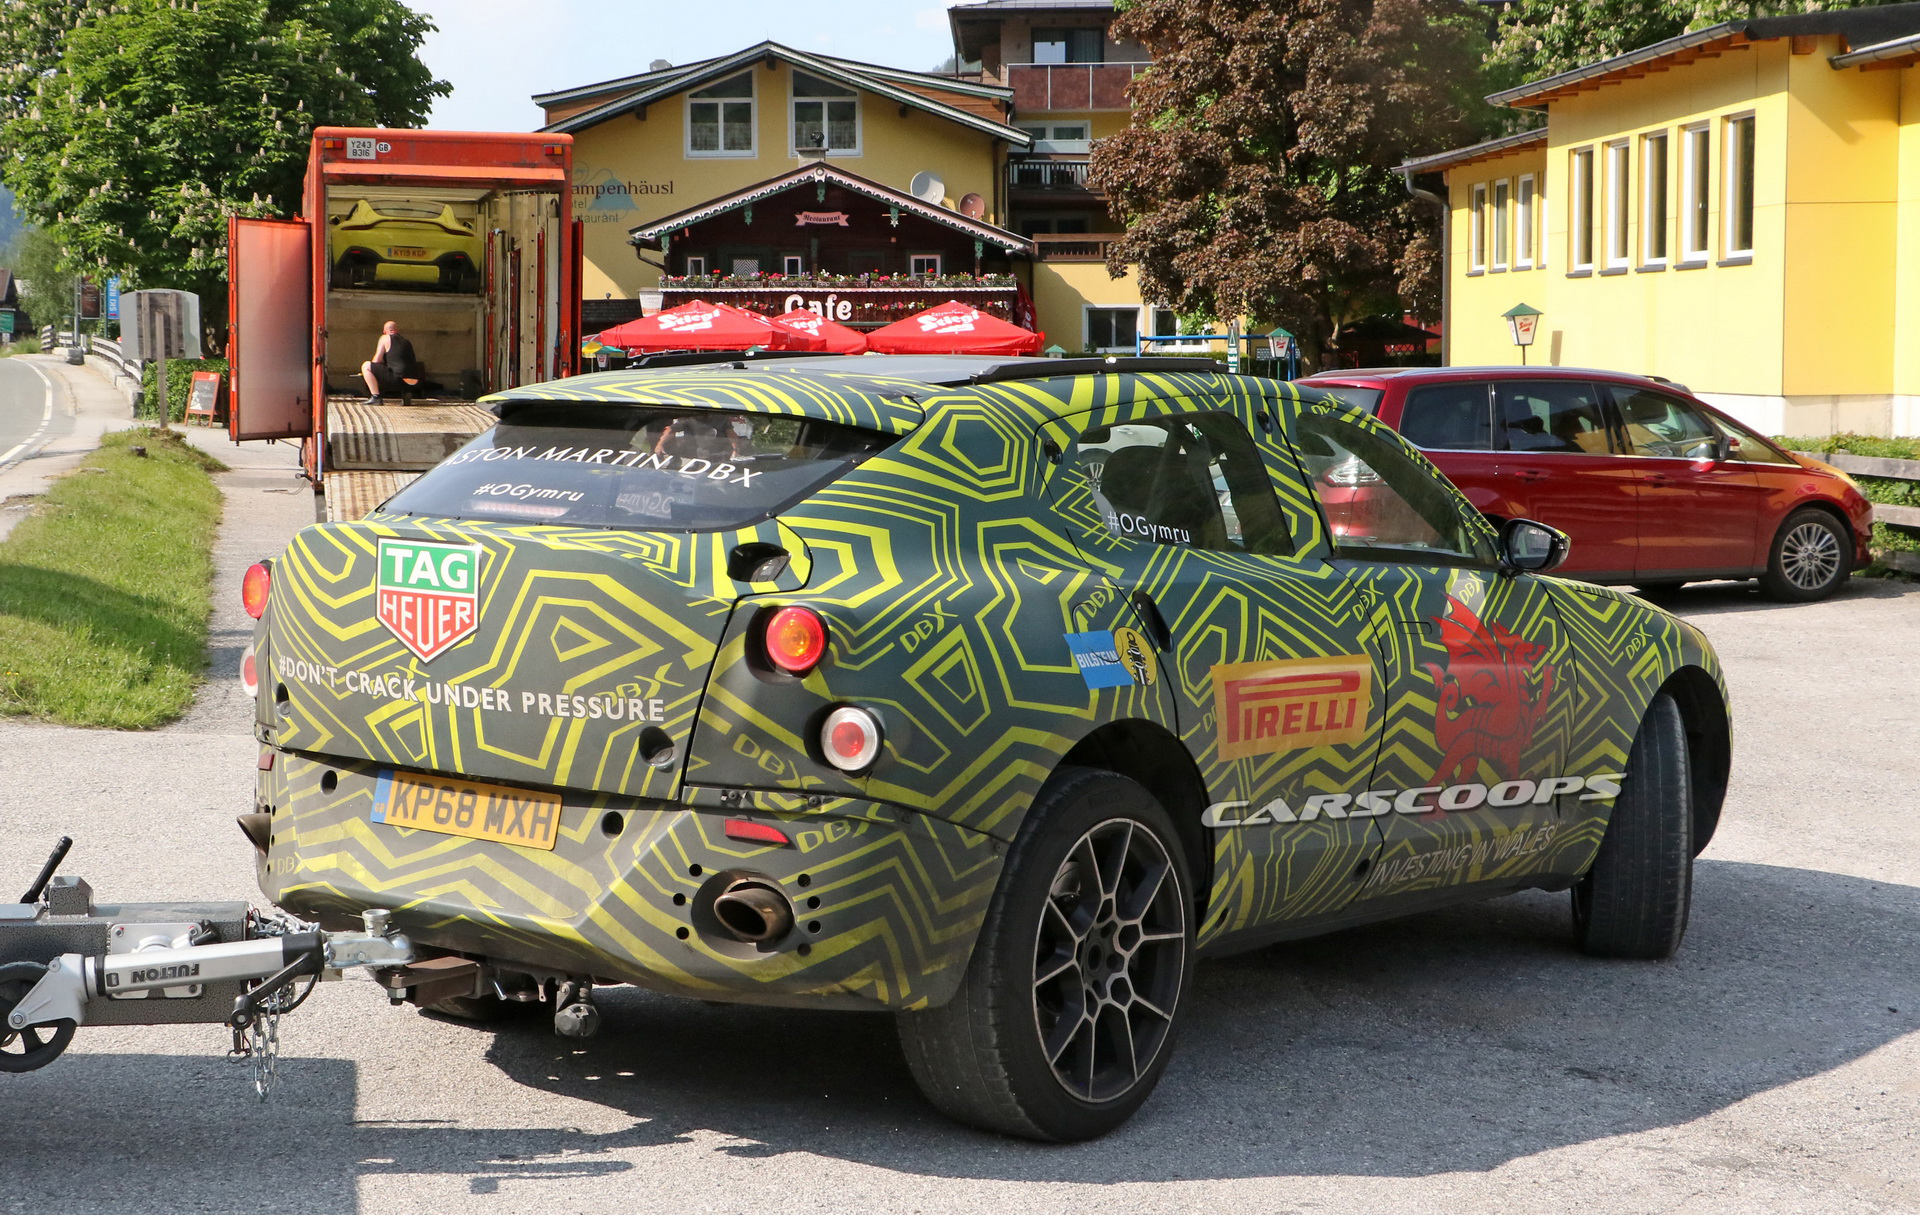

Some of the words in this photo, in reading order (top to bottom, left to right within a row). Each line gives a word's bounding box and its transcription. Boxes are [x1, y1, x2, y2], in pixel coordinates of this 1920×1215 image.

[351, 141, 372, 149] Y243
[352, 149, 370, 157] 8316
[378, 144, 389, 152] GB
[571, 180, 674, 200] ampenhäusl
[572, 212, 619, 224] staurant
[109, 299, 117, 312] SKI
[657, 309, 720, 330] Stiegl
[784, 293, 852, 322] Cafe
[917, 309, 980, 332] Stiegl
[434, 446, 537, 470] ASTON
[535, 446, 674, 471] MARTIN
[678, 458, 763, 488] DBX
[473, 483, 586, 502] #OGymru
[1107, 510, 1191, 543] #OGymru
[385, 547, 469, 590] TAG
[1081, 576, 1125, 618] DBX
[1458, 572, 1487, 606] DBX
[383, 593, 471, 653] HEUER
[899, 599, 958, 654] DBX
[1625, 623, 1653, 660] DBX
[1075, 650, 1121, 669] BILSTEIN
[345, 670, 419, 702] CRACK
[425, 681, 512, 713] UNDER
[522, 691, 665, 722] PRESSURE
[1224, 670, 1361, 744] PIRELLI
[732, 733, 826, 790] DBX
[391, 779, 478, 829] KP68
[483, 792, 556, 842] MXH
[795, 802, 896, 854] DBX
[1365, 844, 1473, 889] INVESTING
[1468, 838, 1497, 867] IN
[131, 963, 200, 984] FULTON
